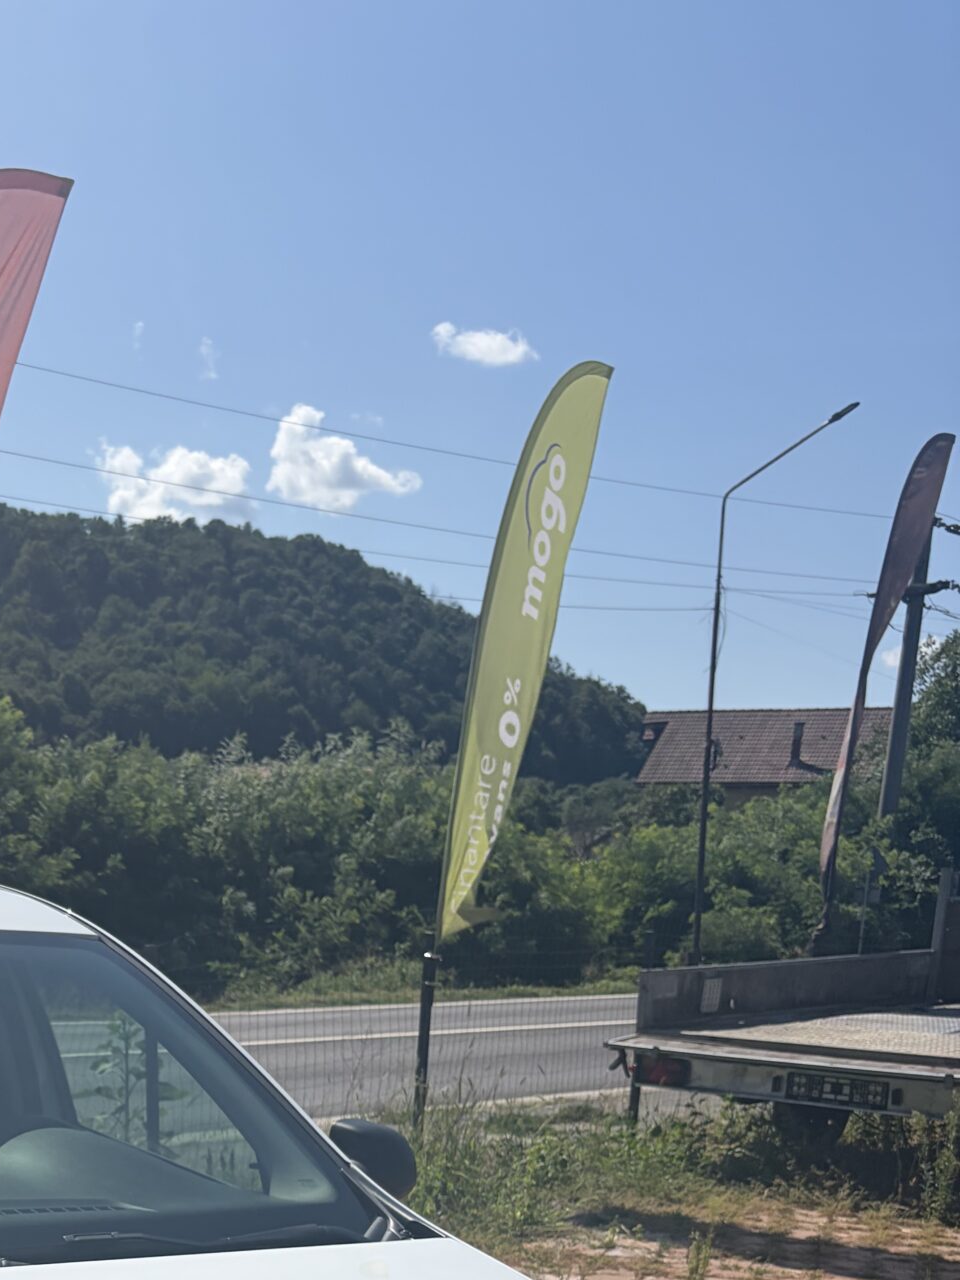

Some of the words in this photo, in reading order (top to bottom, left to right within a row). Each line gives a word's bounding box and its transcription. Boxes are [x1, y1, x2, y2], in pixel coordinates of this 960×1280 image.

[521, 453, 567, 621] mogo
[483, 760, 512, 862] vans
[498, 677, 522, 749] 0%
